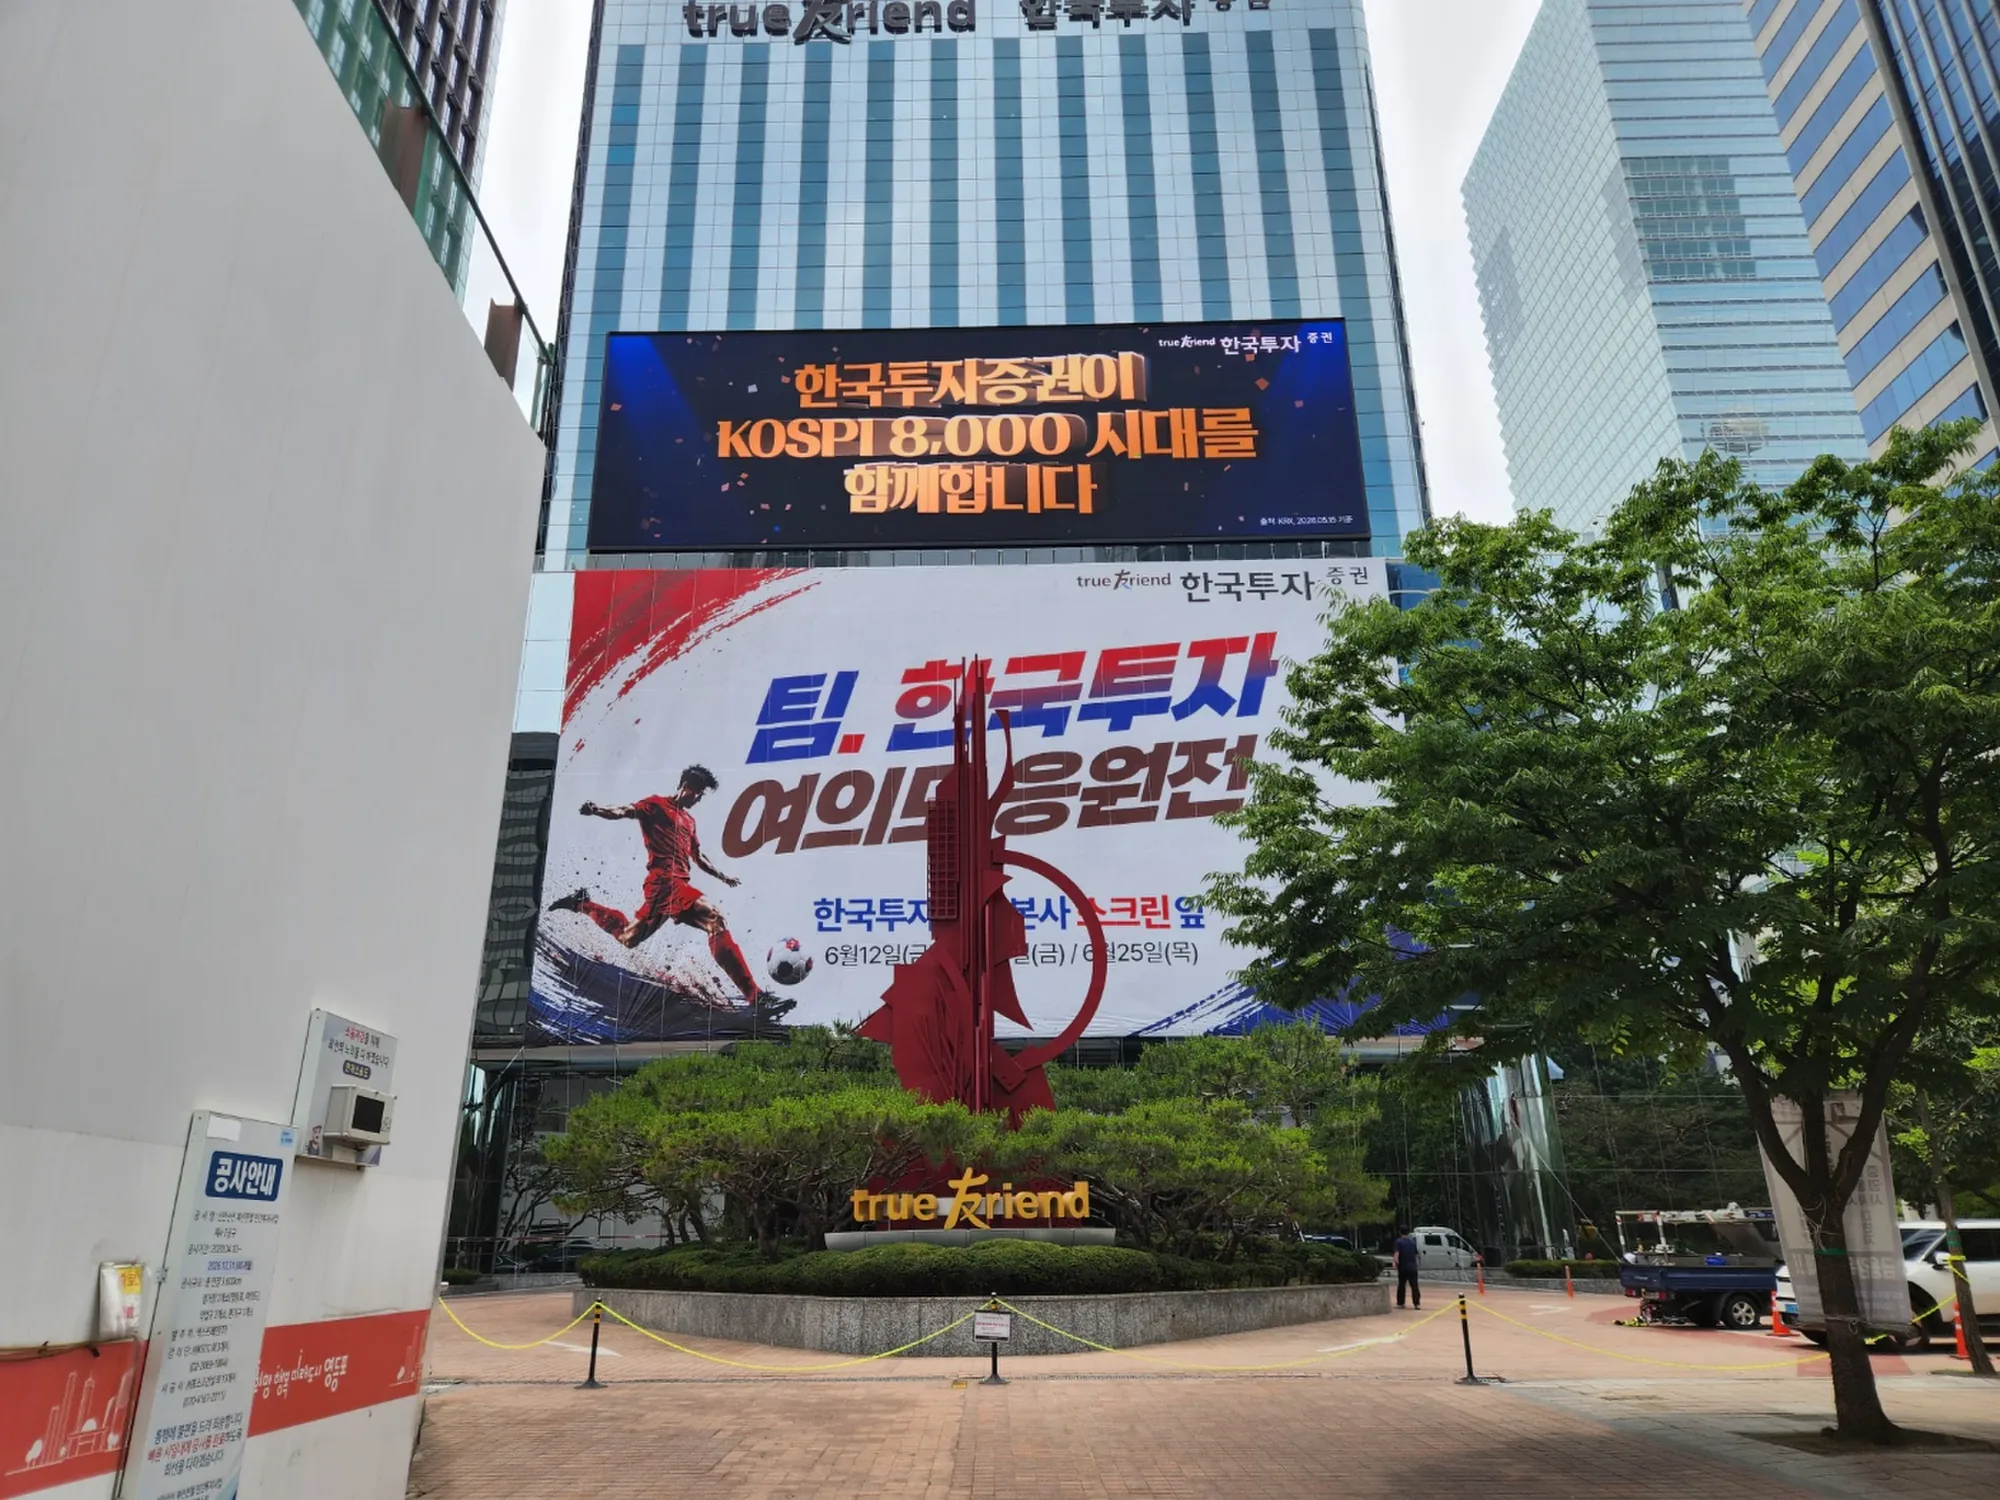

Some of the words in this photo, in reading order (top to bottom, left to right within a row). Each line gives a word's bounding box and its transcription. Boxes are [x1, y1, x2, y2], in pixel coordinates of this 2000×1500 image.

[1220, 335, 1302, 355] 한국투자
[1307, 332, 1333, 343] 증권
[794, 352, 1142, 409] 한국투자증권이
[717, 418, 874, 459] KOSPI
[889, 413, 1080, 458] 8,000
[1086, 407, 1259, 459] 시대를
[843, 463, 1098, 515] 함께합니다
[1076, 575, 1111, 588] true
[1180, 571, 1315, 603] 한국투자
[1326, 566, 1369, 586] 증권
[746, 670, 866, 764] 팀.
[886, 631, 1279, 752] 한국투자
[995, 734, 1259, 837] 응원전
[214, 1157, 277, 1197] 공사안내
[850, 1189, 937, 1222] true
[324, 1355, 349, 1392] 영등포
